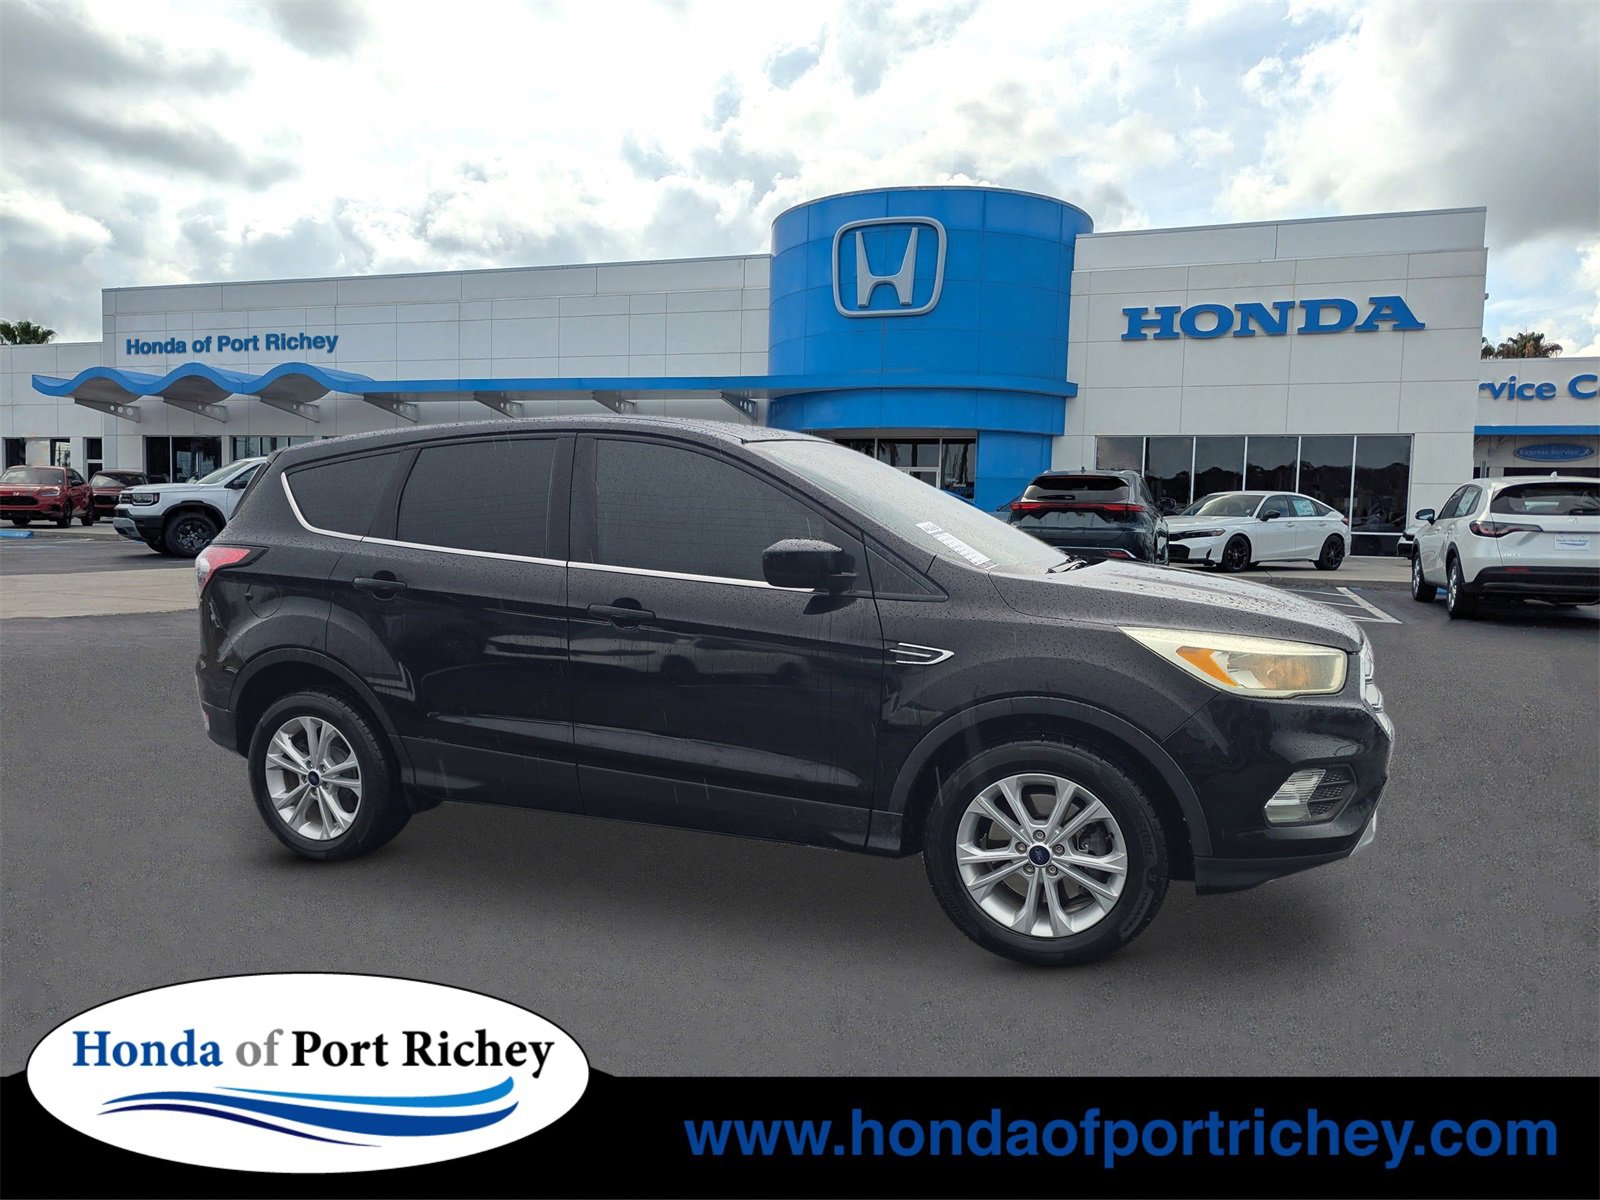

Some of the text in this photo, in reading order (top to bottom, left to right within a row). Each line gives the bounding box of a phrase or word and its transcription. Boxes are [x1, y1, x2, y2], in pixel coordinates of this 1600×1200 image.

[1120, 295, 1426, 341] HONDA
[125, 331, 339, 356] Honda of Port Richey
[1567, 373, 1600, 400] C
